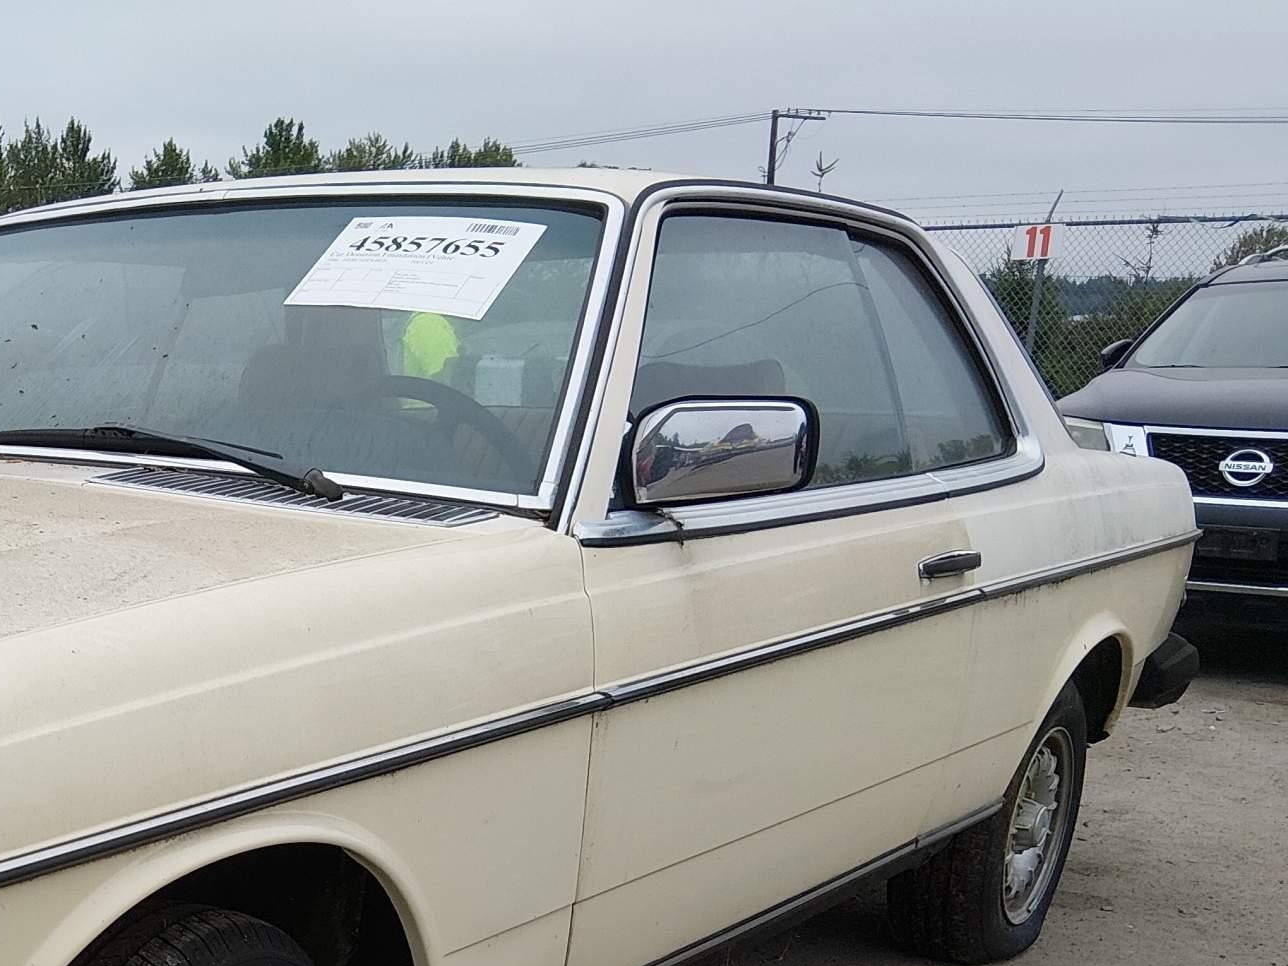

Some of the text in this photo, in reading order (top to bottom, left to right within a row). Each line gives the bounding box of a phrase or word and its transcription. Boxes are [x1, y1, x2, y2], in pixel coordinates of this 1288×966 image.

[349, 235, 508, 258] 45857655
[1025, 226, 1052, 258] 11
[1224, 463, 1267, 471] NISSAN
